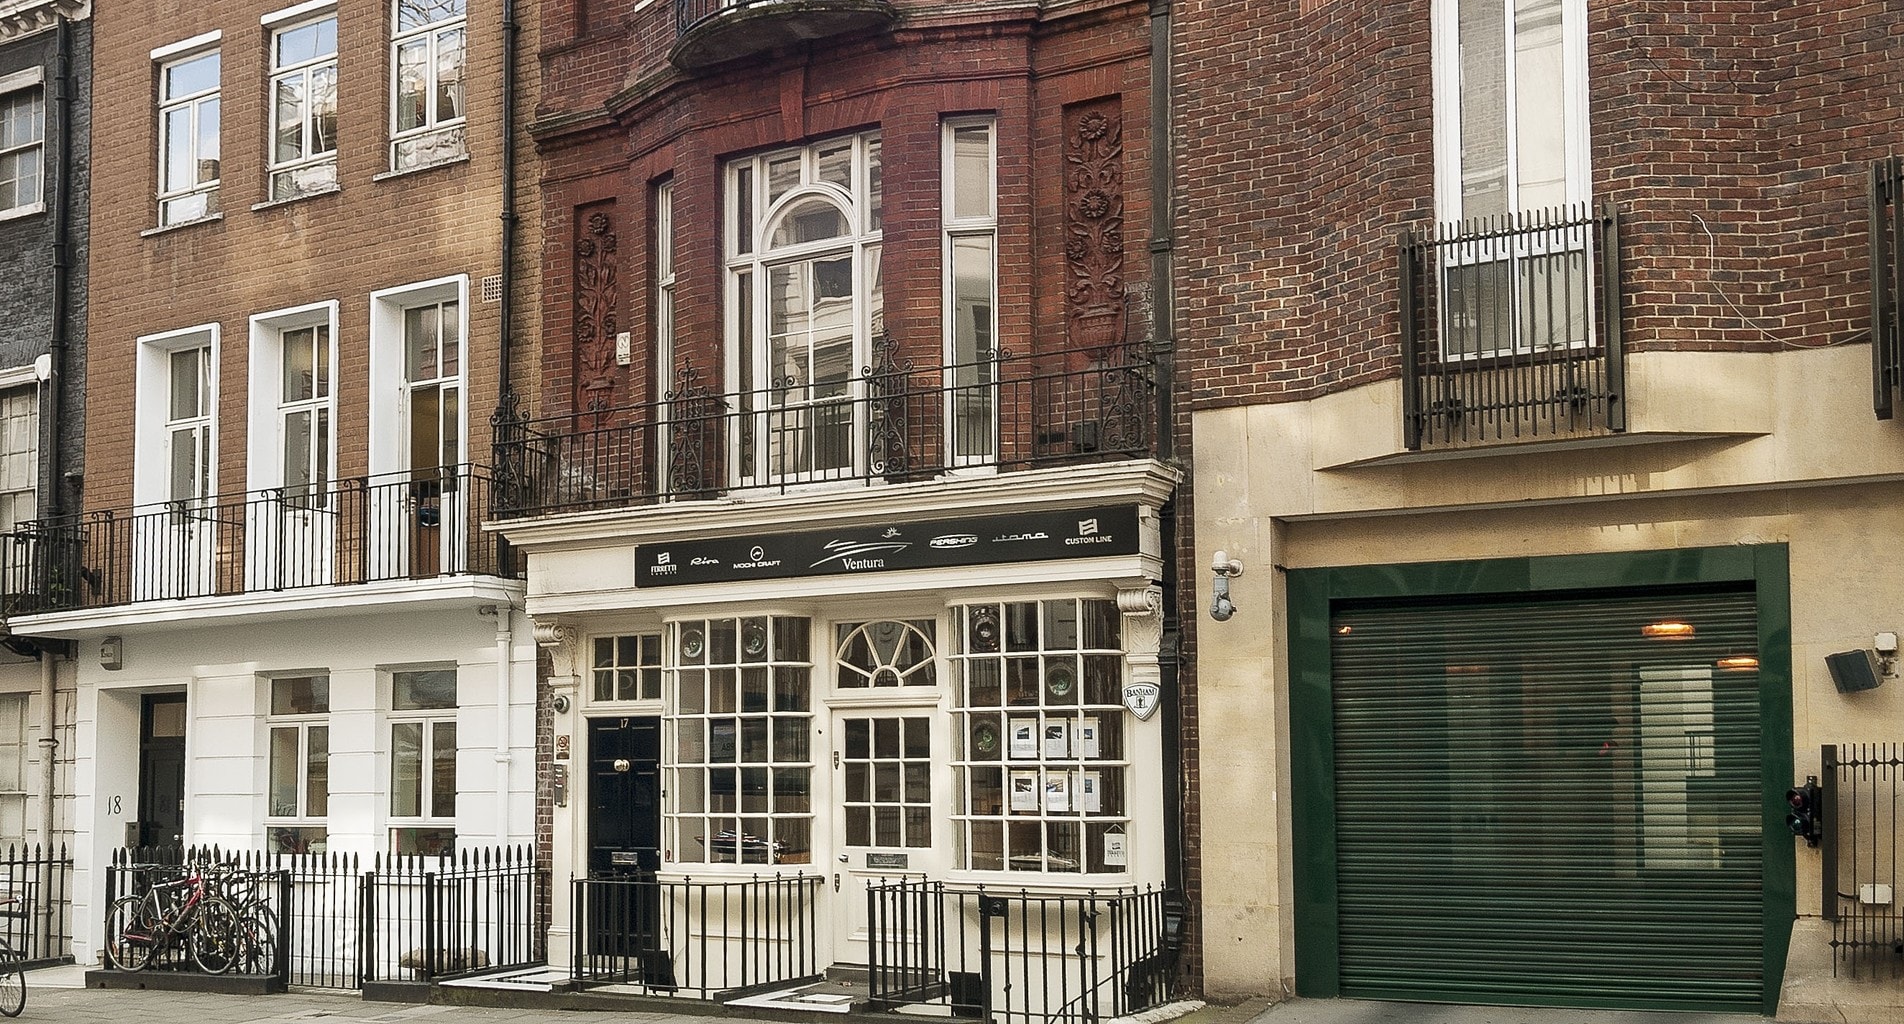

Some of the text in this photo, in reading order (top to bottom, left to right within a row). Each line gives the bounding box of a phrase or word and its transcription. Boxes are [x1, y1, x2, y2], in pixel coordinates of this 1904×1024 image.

[1095, 535, 1113, 544] LINE
[842, 557, 885, 570] Ventura
[620, 718, 629, 729] 17
[107, 795, 121, 816] 18
